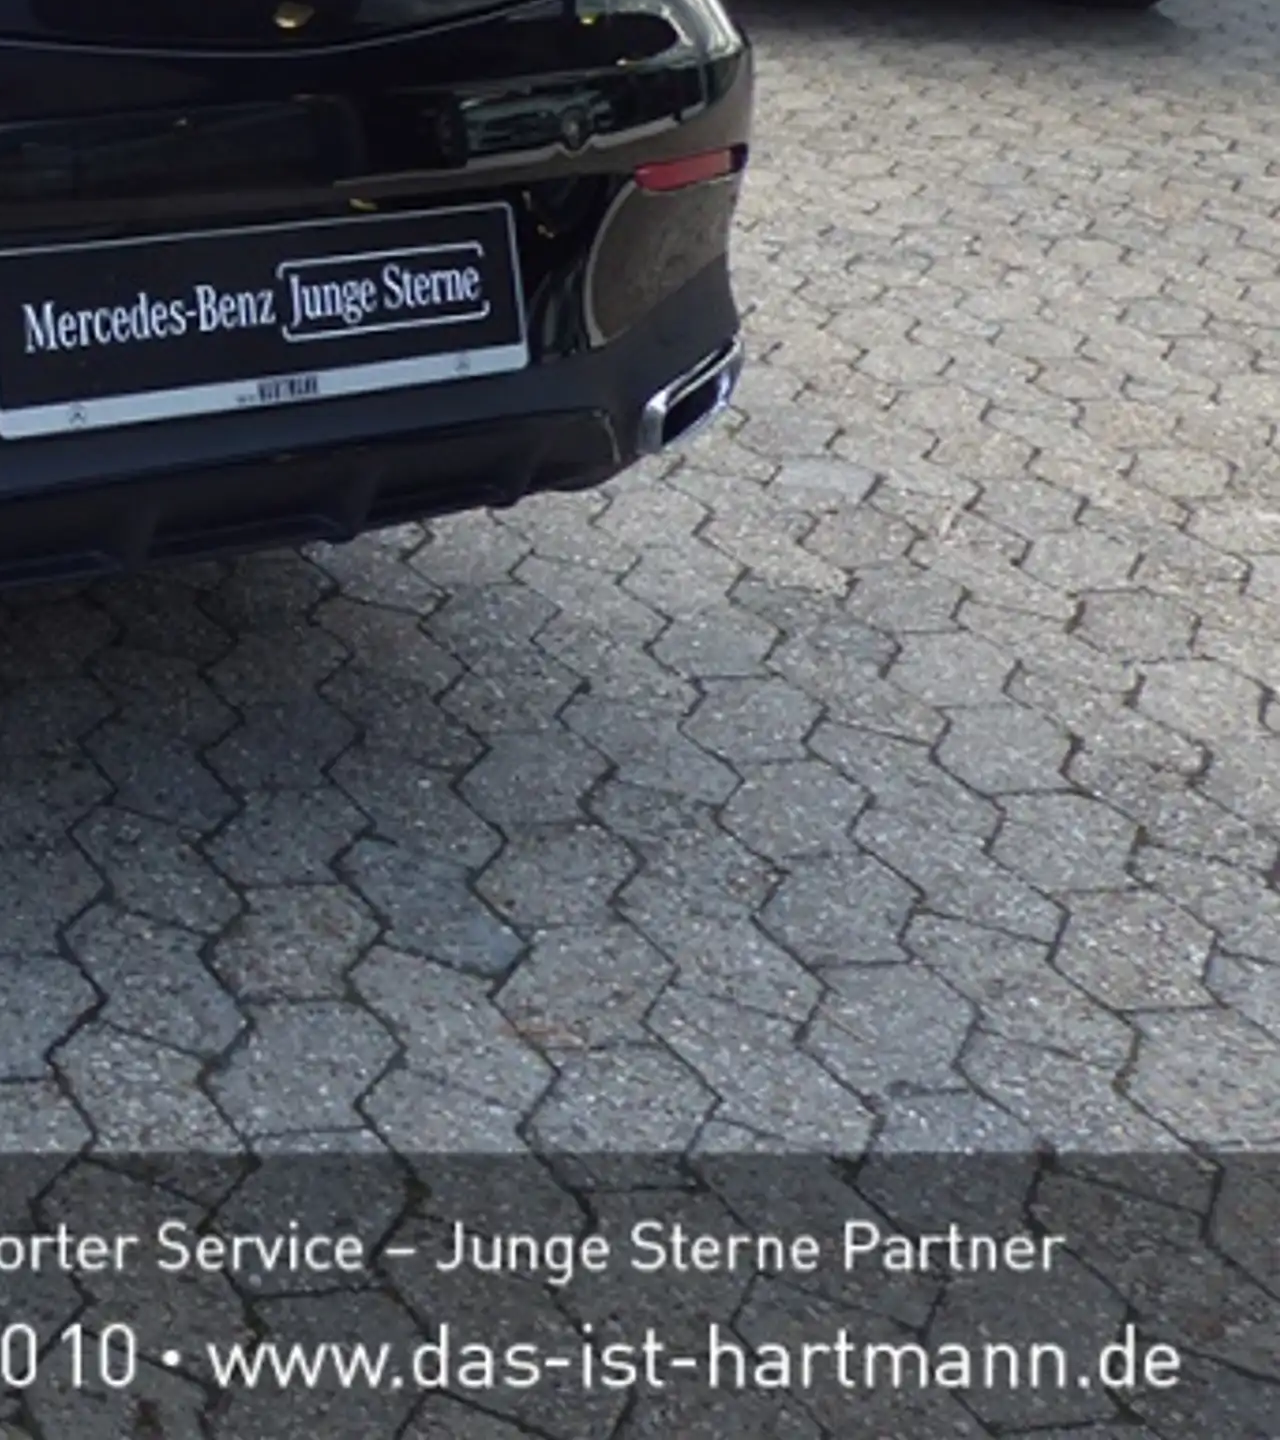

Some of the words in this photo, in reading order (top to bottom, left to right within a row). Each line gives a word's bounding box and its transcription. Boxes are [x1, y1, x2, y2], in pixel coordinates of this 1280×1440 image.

[23, 283, 276, 353] Mercedes-Benz
[288, 271, 378, 327] Junge
[382, 262, 481, 310] Sterne
